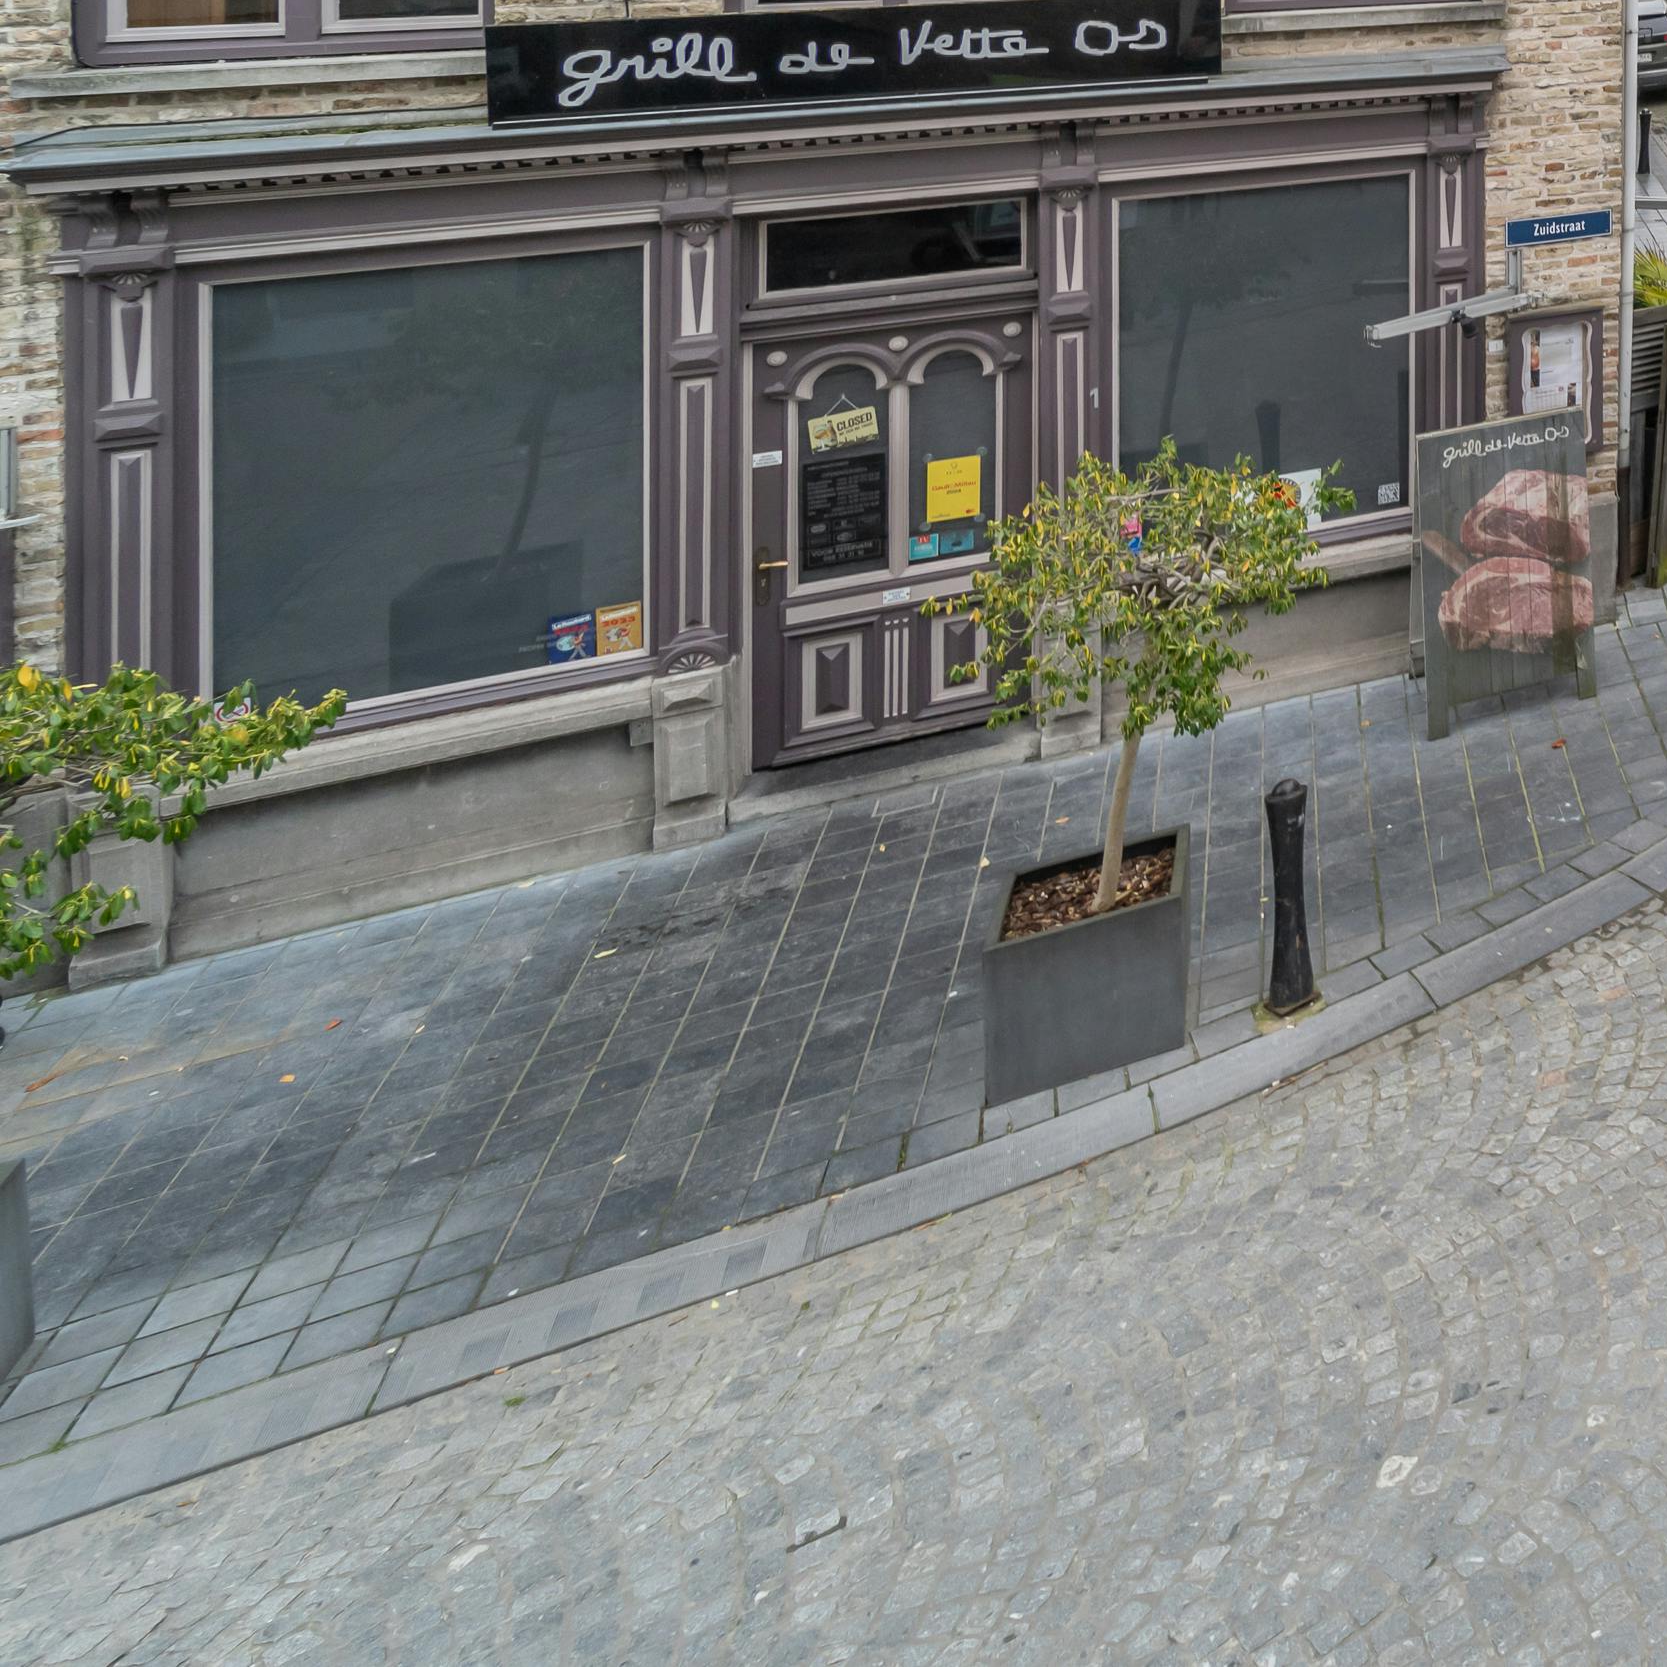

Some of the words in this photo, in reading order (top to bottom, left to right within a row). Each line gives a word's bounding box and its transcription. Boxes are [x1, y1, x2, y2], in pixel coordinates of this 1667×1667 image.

[1533, 220, 1586, 237] Zuidstraat
[1089, 387, 1100, 409] 1
[836, 412, 873, 432] CLOSED
